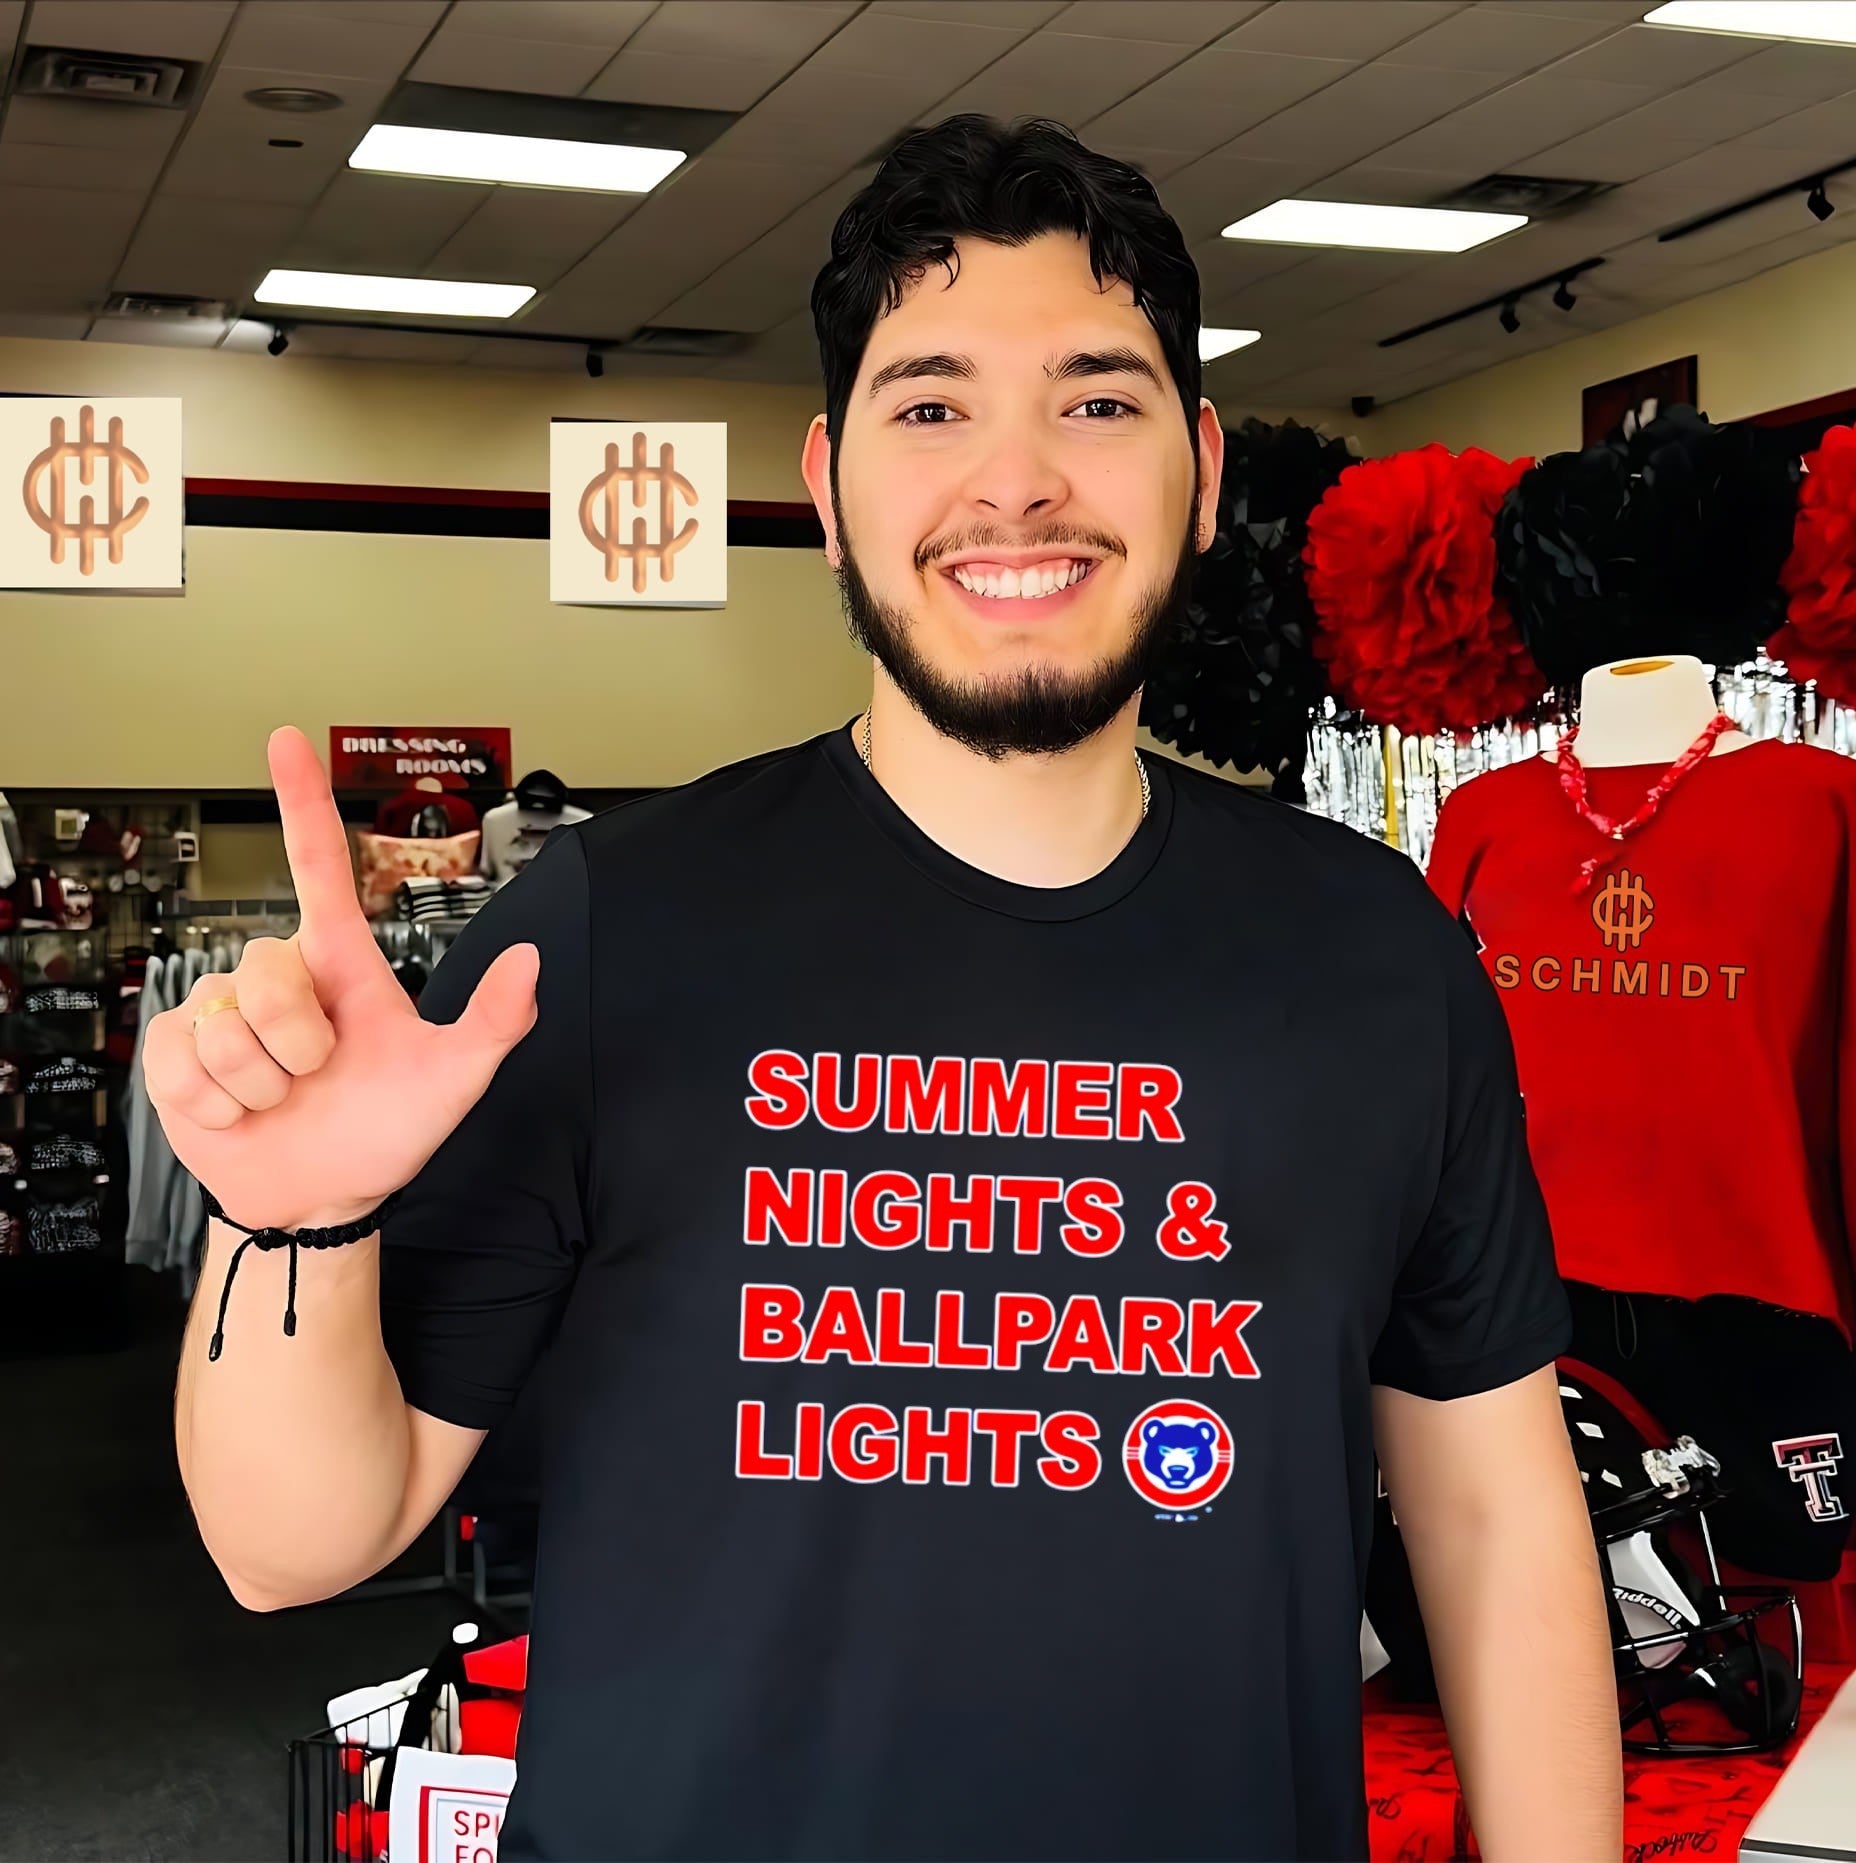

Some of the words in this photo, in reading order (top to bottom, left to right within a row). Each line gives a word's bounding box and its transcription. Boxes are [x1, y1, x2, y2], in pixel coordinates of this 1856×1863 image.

[341, 736, 467, 754] DRESSING
[396, 758, 487, 775] ROOMS
[1493, 953, 1746, 1000] SCHMIDT
[744, 1048, 1186, 1143] SUMMER
[743, 1166, 1126, 1258] NIGHTS
[1156, 1180, 1233, 1262] &
[738, 1283, 1263, 1380] BALLPARK
[735, 1400, 1103, 1491] LIGHTS
[1612, 1587, 1682, 1627] Riddell
